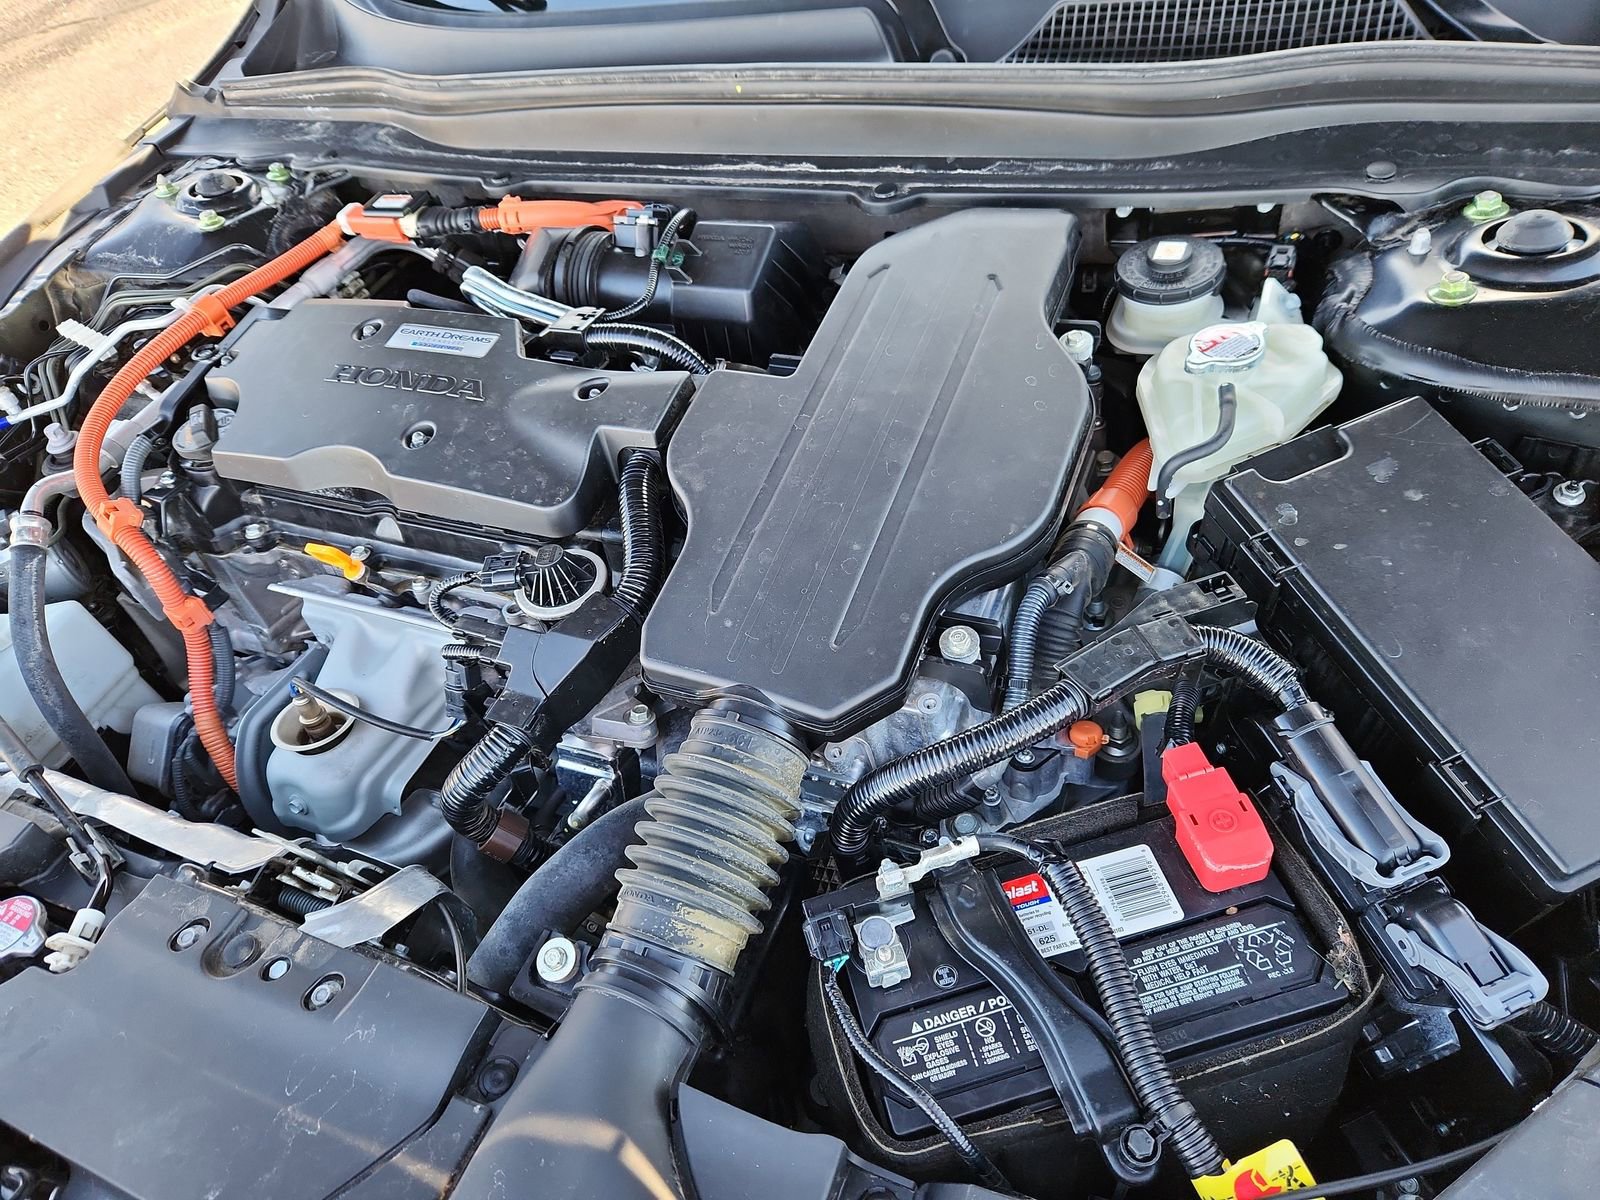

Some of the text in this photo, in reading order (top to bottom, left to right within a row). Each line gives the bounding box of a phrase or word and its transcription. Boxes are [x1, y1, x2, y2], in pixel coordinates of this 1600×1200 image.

[400, 328, 440, 337] EARTH
[441, 331, 493, 343] DREAMS
[323, 364, 486, 401] HONDA
[1016, 900, 1040, 910] TOUGH
[1027, 924, 1049, 935] 51-DL
[1039, 935, 1056, 945] 625
[1176, 938, 1189, 946] THE
[1133, 957, 1142, 965] DO
[1142, 954, 1154, 962] NOT
[1180, 942, 1195, 950] VENT
[1137, 945, 1219, 977] FLUSH EYES IMMEDIATELY
[1140, 972, 1159, 983] WITH
[1144, 964, 1209, 991] MEDICAL HELP FAST
[1267, 966, 1295, 979] RECCLE
[1154, 991, 1166, 1000] FOR
[1193, 975, 1219, 988] STARTING
[1218, 968, 1240, 980] FOLLOW
[1153, 1001, 1180, 1014] AVAILABLE
[923, 1005, 977, 1030] DANGER
[934, 1030, 959, 1043] SHIELD
[984, 1035, 995, 1044] NO
[936, 1039, 955, 1050] EYES
[923, 1045, 961, 1062] EXPLOSIVE
[925, 1056, 950, 1069] GASES
[911, 1072, 924, 1081] CAN
[939, 1058, 968, 1072] BLINDNESS
[930, 1074, 938, 1082] OR
